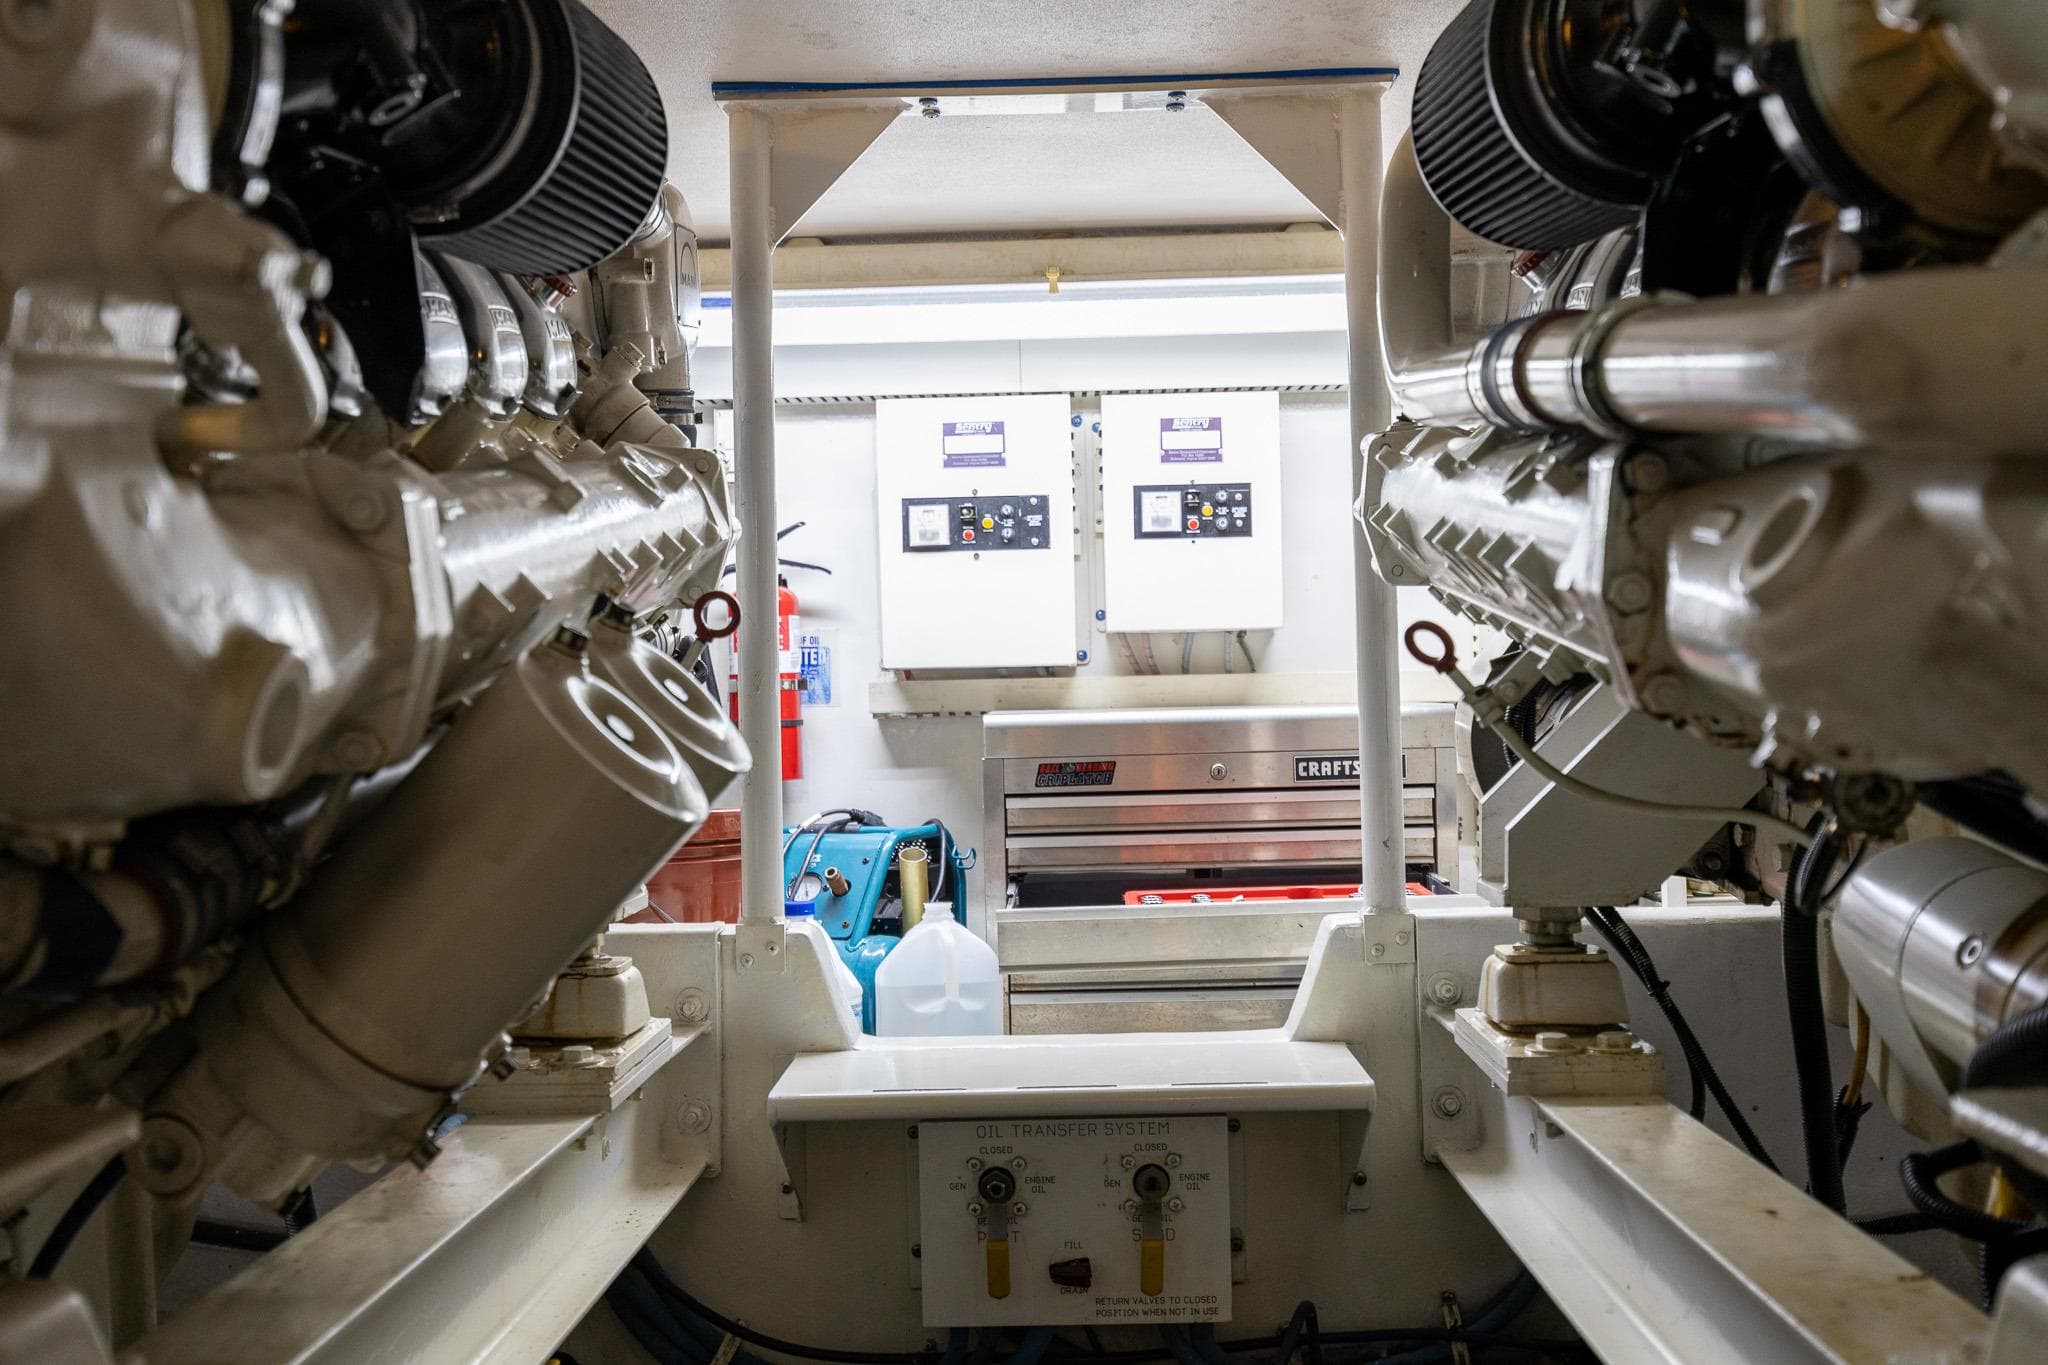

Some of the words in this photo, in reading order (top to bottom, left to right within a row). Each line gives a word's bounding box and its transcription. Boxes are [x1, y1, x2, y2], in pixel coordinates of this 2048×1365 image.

[1298, 760, 1361, 777] CRAFTS
[1038, 772, 1112, 786] GRIPLATCH
[976, 1124, 1003, 1139] OIL
[1011, 1122, 1097, 1138] TRANSFER
[1104, 1121, 1170, 1136] SYSTEM
[979, 1146, 1013, 1154] CLOSED
[1134, 1143, 1167, 1151] CLOSED
[1024, 1176, 1056, 1184] ENGINE
[1179, 1173, 1211, 1182] ENGINE
[950, 1183, 966, 1191] GEN
[1104, 1179, 1121, 1188] GEN
[1186, 1183, 1201, 1191] OIL
[977, 1230, 1021, 1245] PT
[1132, 1228, 1176, 1242] SD
[1064, 1241, 1082, 1249] FILL
[1060, 1286, 1089, 1295] DRAIN
[1095, 1297, 1130, 1306] RETURN
[1132, 1296, 1166, 1305] VALVES
[1169, 1296, 1181, 1304] TO
[1184, 1295, 1217, 1304] CLOSED
[1096, 1309, 1139, 1318] POSITION
[1142, 1308, 1167, 1317] WHEN
[1169, 1307, 1186, 1316] NOT
[1191, 1307, 1200, 1316] IN
[1203, 1307, 1219, 1315] USE
